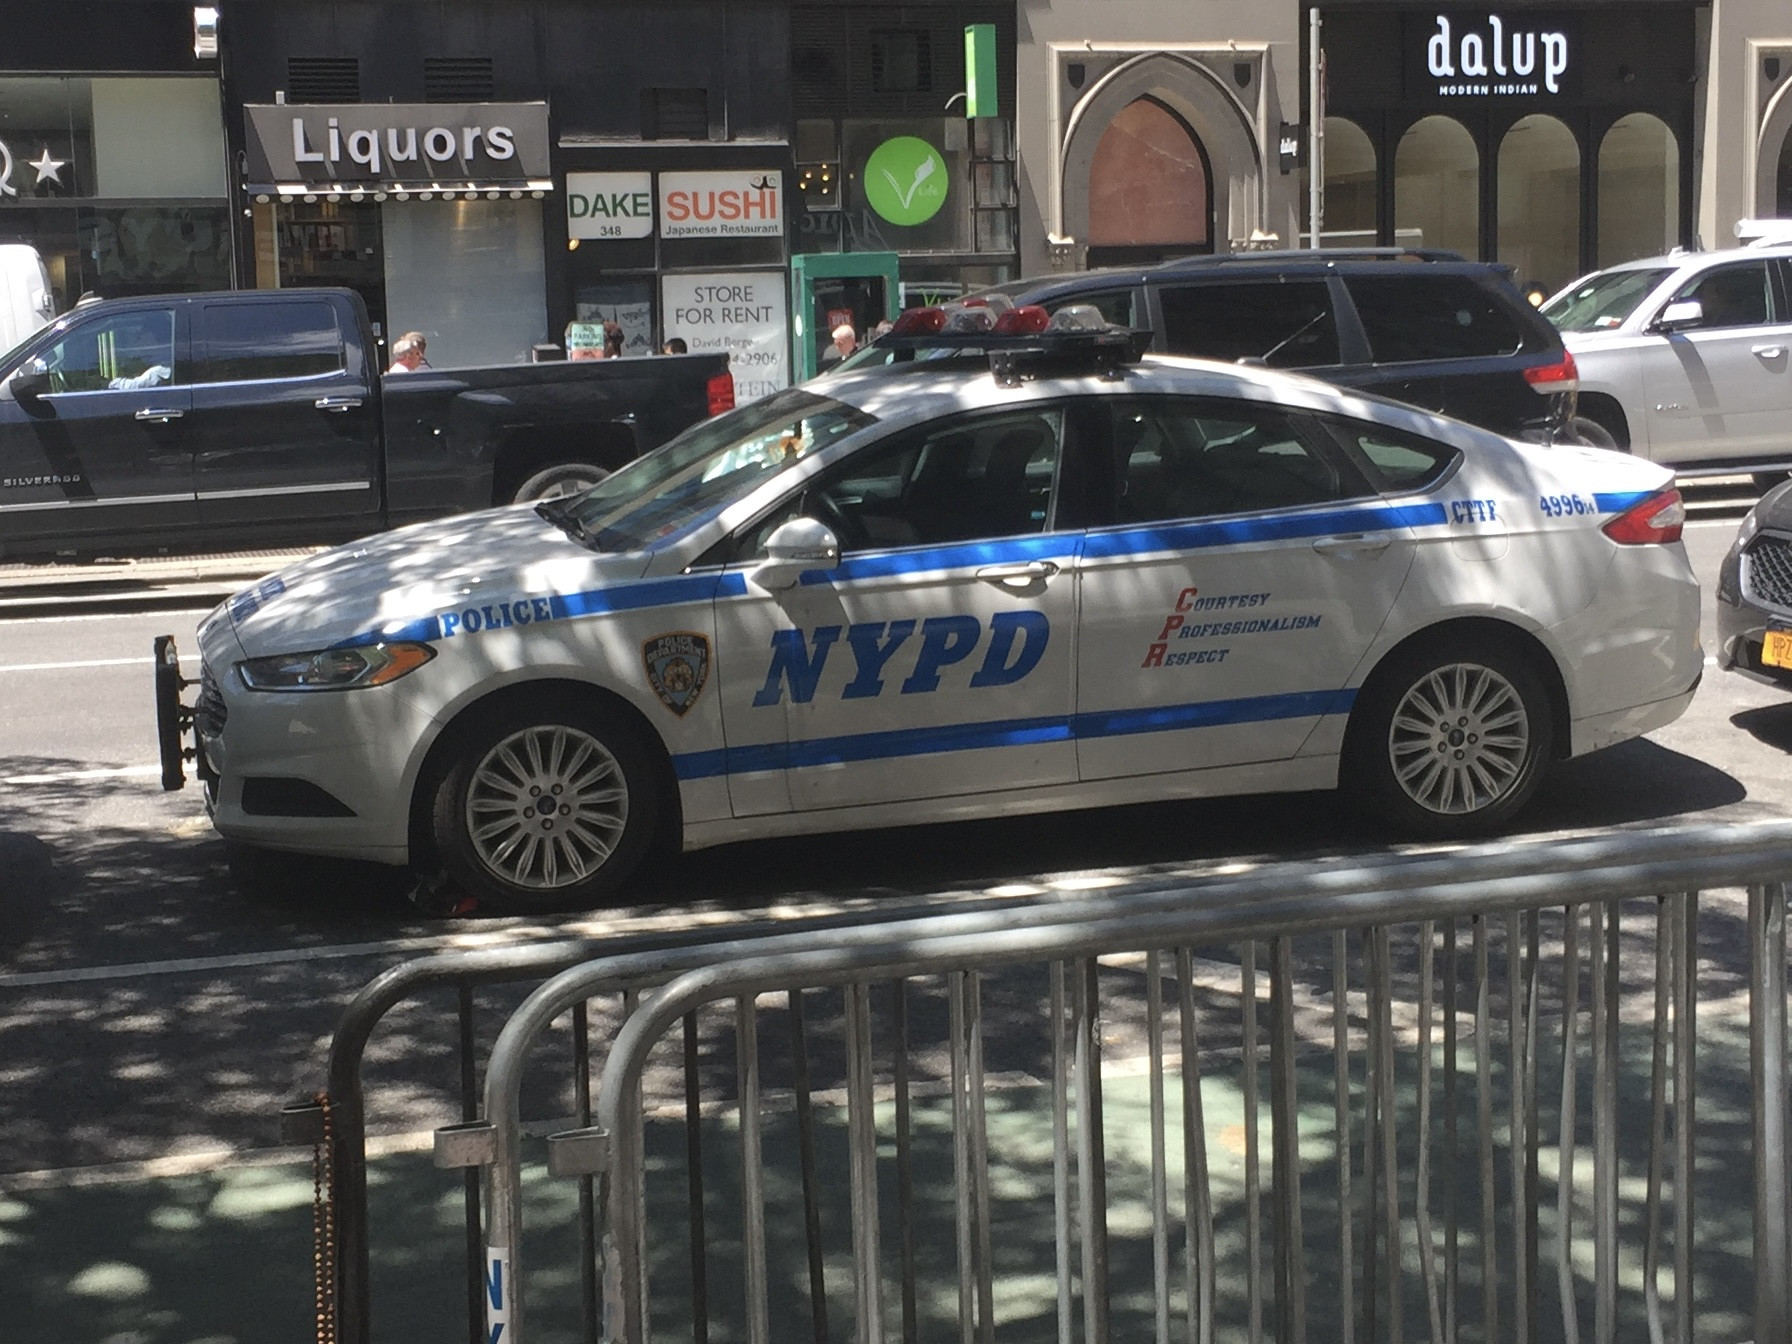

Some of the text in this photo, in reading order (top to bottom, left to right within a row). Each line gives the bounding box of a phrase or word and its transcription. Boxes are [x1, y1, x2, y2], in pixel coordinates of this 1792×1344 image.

[1428, 15, 1567, 94] dalup
[1439, 84, 1538, 96] MODERN INDIAN
[292, 118, 515, 174] Liquors
[568, 193, 650, 219] DAKE
[666, 190, 776, 222] SUSHI
[600, 226, 622, 237] 348
[666, 223, 779, 237] Japanese Restaurant
[694, 285, 754, 303] STORE
[675, 306, 773, 325] FOR RENT
[692, 337, 721, 349] David
[3, 474, 81, 487] SILVERADO
[1451, 500, 1497, 524] CTTF
[1540, 494, 1585, 517] 4996
[440, 596, 551, 638] POLICE
[658, 635, 693, 648] POLICE
[647, 643, 706, 665] DEPARTMENT
[751, 609, 1050, 708] NYPD
